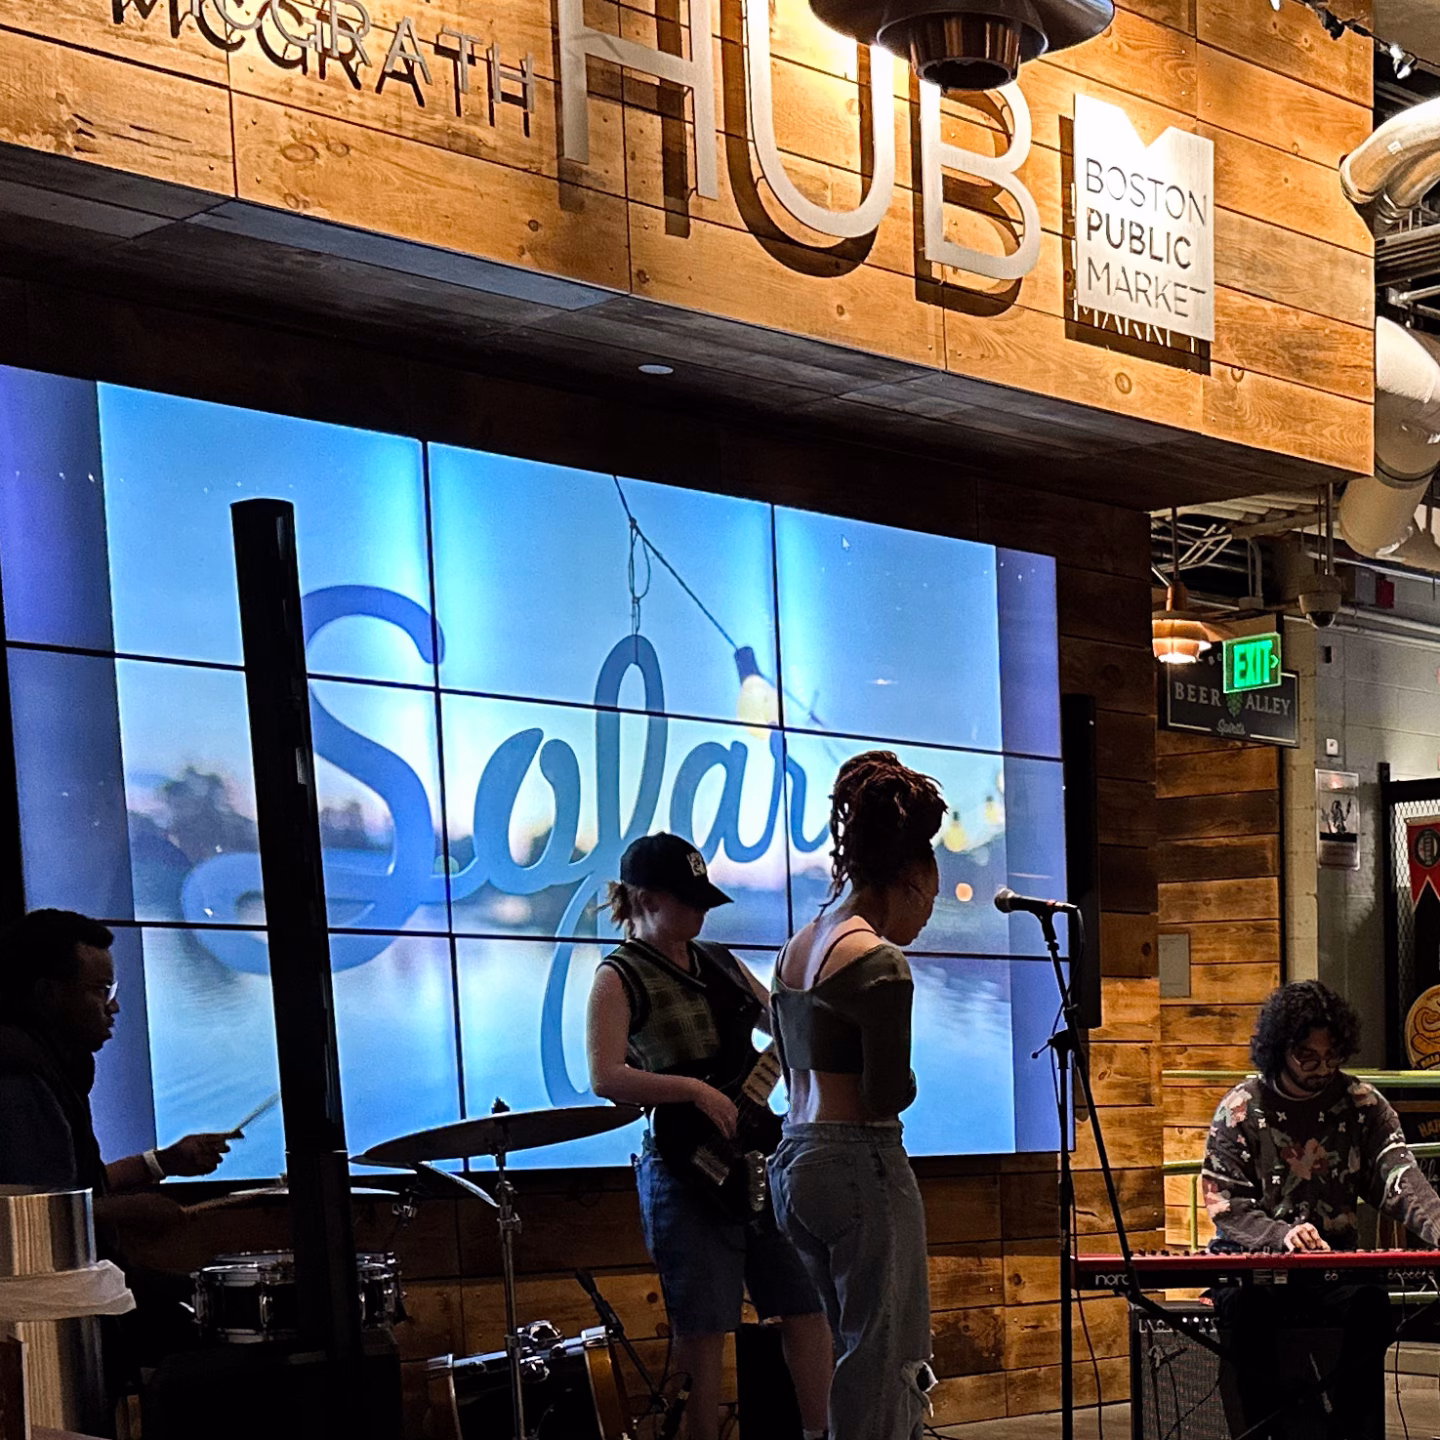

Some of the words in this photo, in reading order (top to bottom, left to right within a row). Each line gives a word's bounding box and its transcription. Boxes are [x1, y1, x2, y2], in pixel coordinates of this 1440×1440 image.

[558, 0, 1040, 280] HUB
[1086, 157, 1207, 226] BOSTON
[1086, 207, 1191, 269] PUBLIC
[1087, 256, 1206, 318] MARKET
[1234, 639, 1273, 688] EXIT
[1174, 682, 1222, 707] BEER
[1245, 694, 1291, 716] ALLEY
